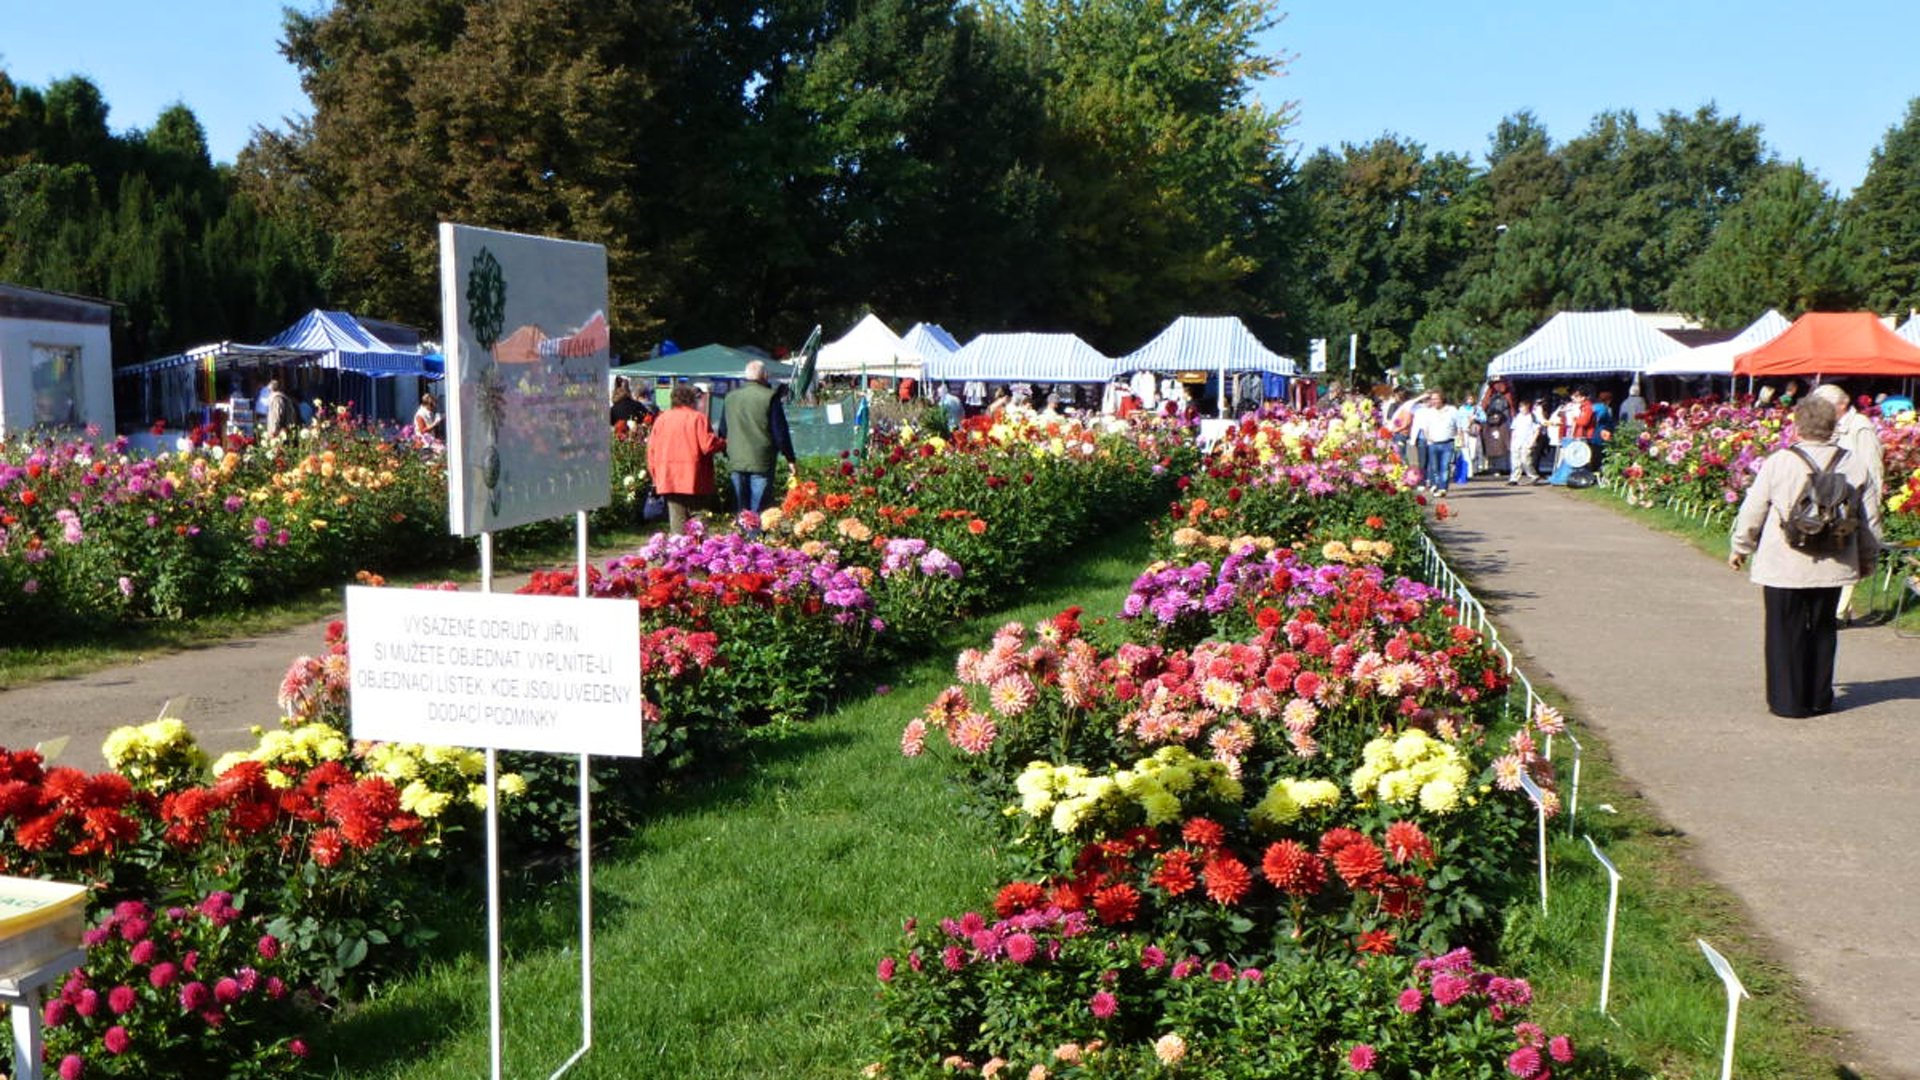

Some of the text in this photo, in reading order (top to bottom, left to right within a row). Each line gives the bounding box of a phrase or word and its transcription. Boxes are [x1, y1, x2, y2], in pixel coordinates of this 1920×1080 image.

[480, 619, 540, 641] ODRUDY
[373, 641, 387, 661] SI
[490, 677, 520, 699] KDE
[522, 679, 561, 701] JSOU
